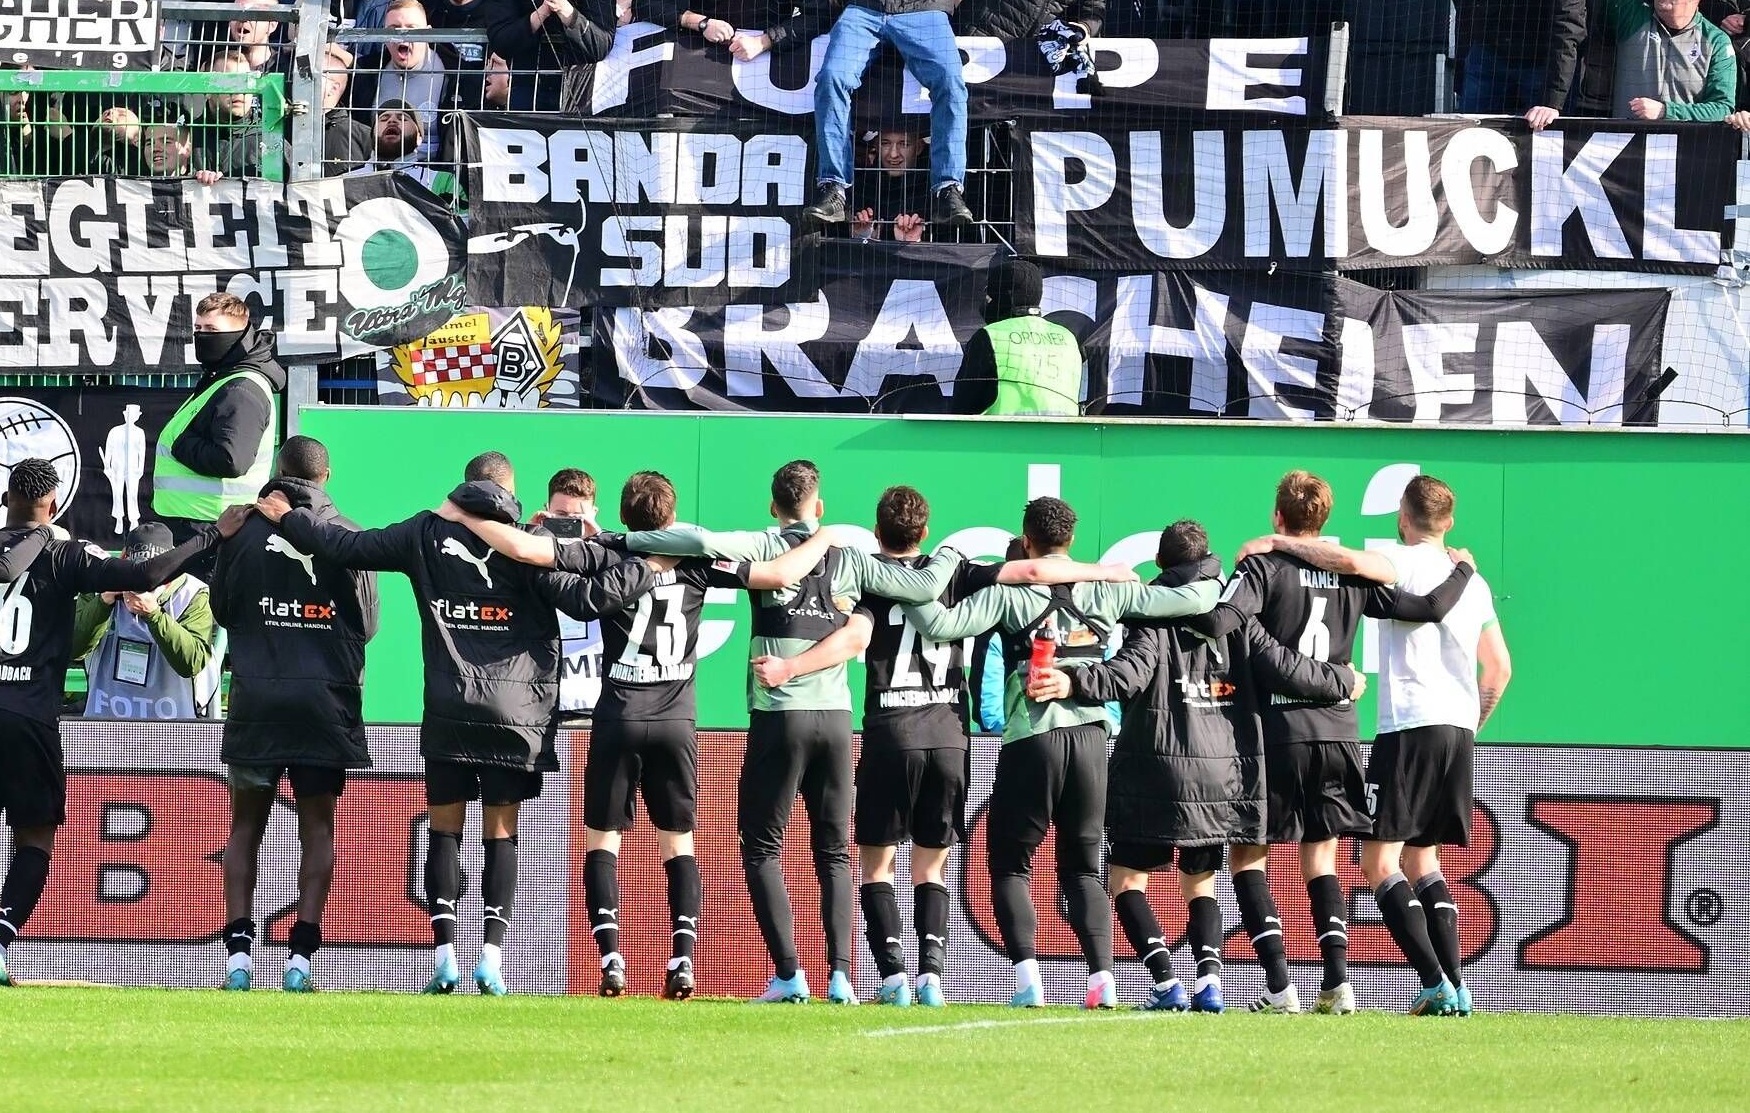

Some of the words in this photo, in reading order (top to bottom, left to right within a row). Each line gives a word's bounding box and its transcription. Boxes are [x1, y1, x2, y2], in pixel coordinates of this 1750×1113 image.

[479, 128, 808, 206] BANDA
[1031, 127, 1722, 264] PUMUCKL
[600, 214, 794, 289] SUD
[1009, 330, 1068, 346] ORDNER
[1299, 567, 1341, 590] KRAMER
[618, 585, 688, 668] 23
[1297, 595, 1331, 663] 6
[94, 688, 179, 720] FOTO
